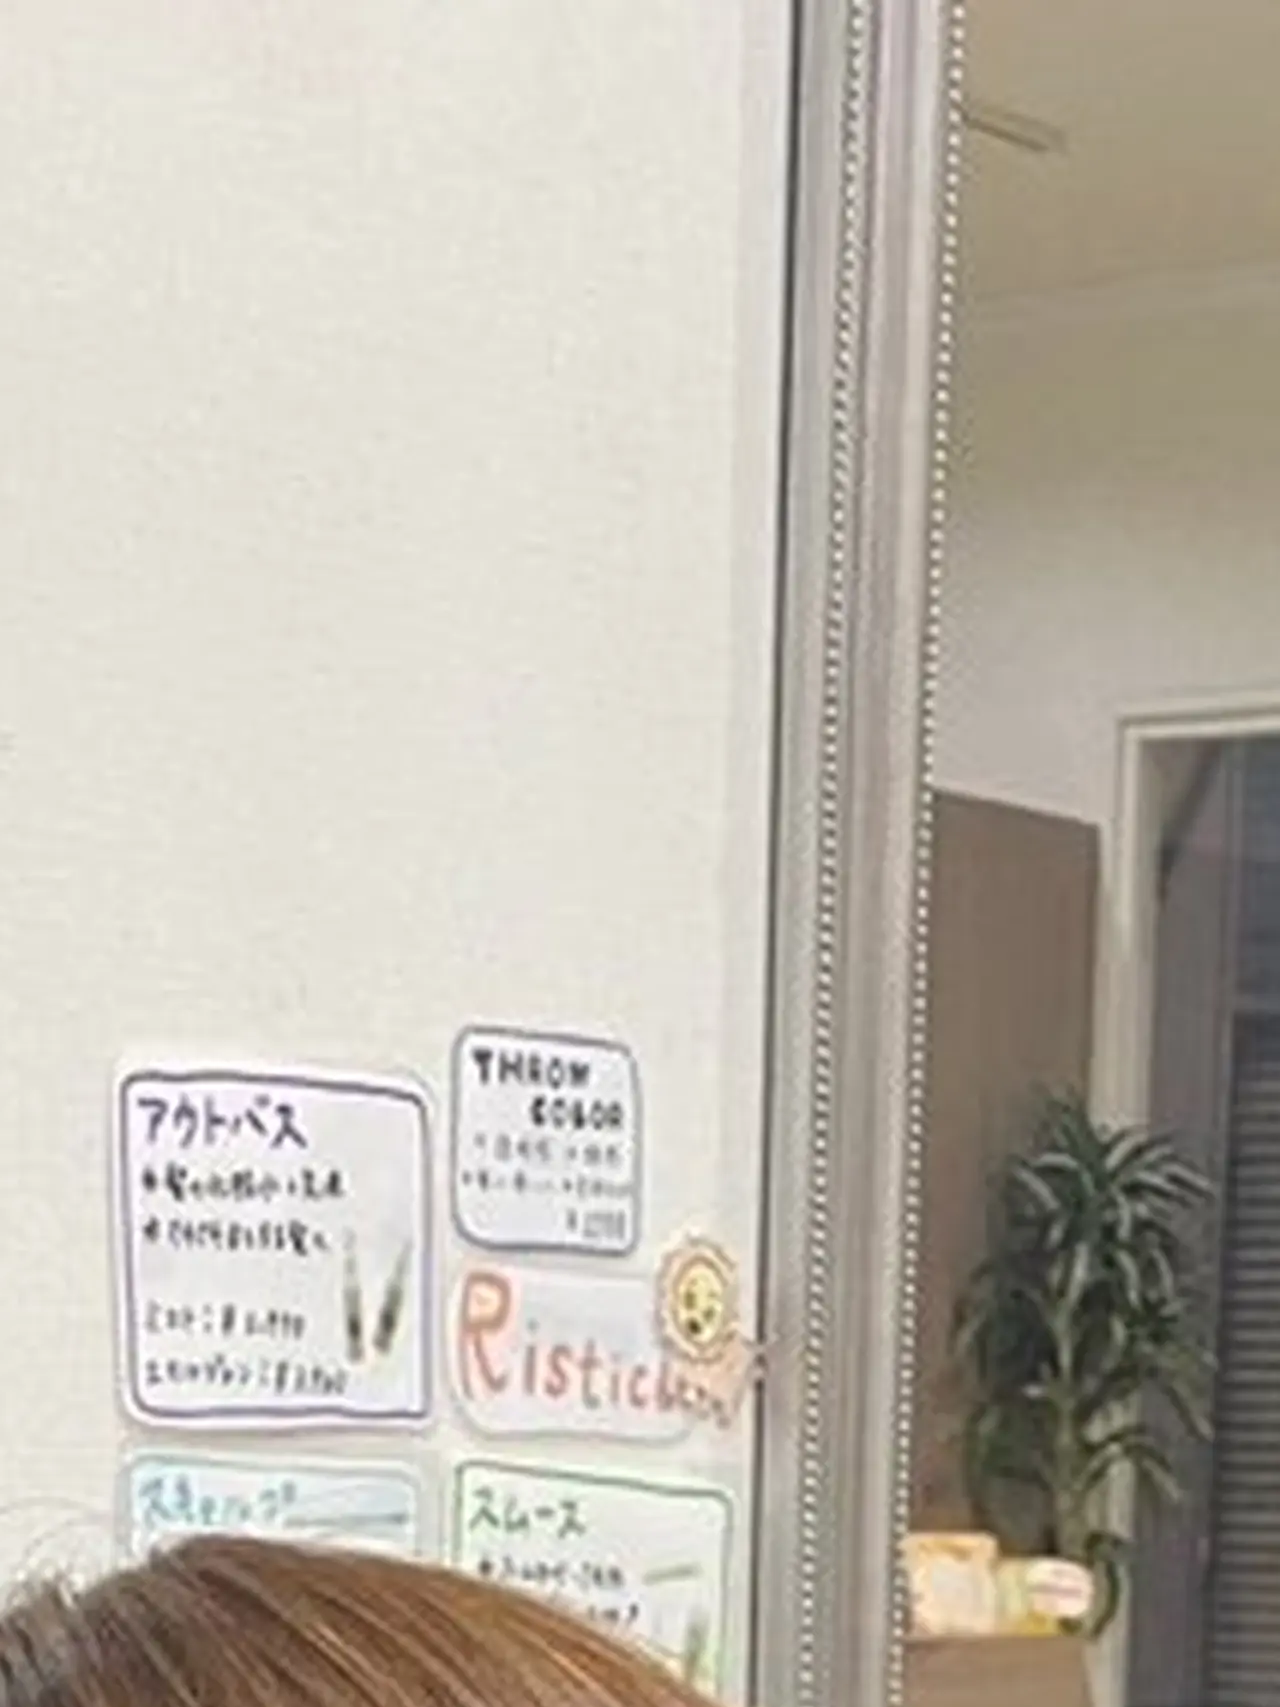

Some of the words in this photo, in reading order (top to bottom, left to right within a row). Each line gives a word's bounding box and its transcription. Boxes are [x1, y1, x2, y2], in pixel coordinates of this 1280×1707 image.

[471, 1047, 591, 1089] THROW
[136, 1092, 309, 1150] アウトバス
[529, 1094, 624, 1131] COLOR
[468, 1486, 587, 1540] スムース
